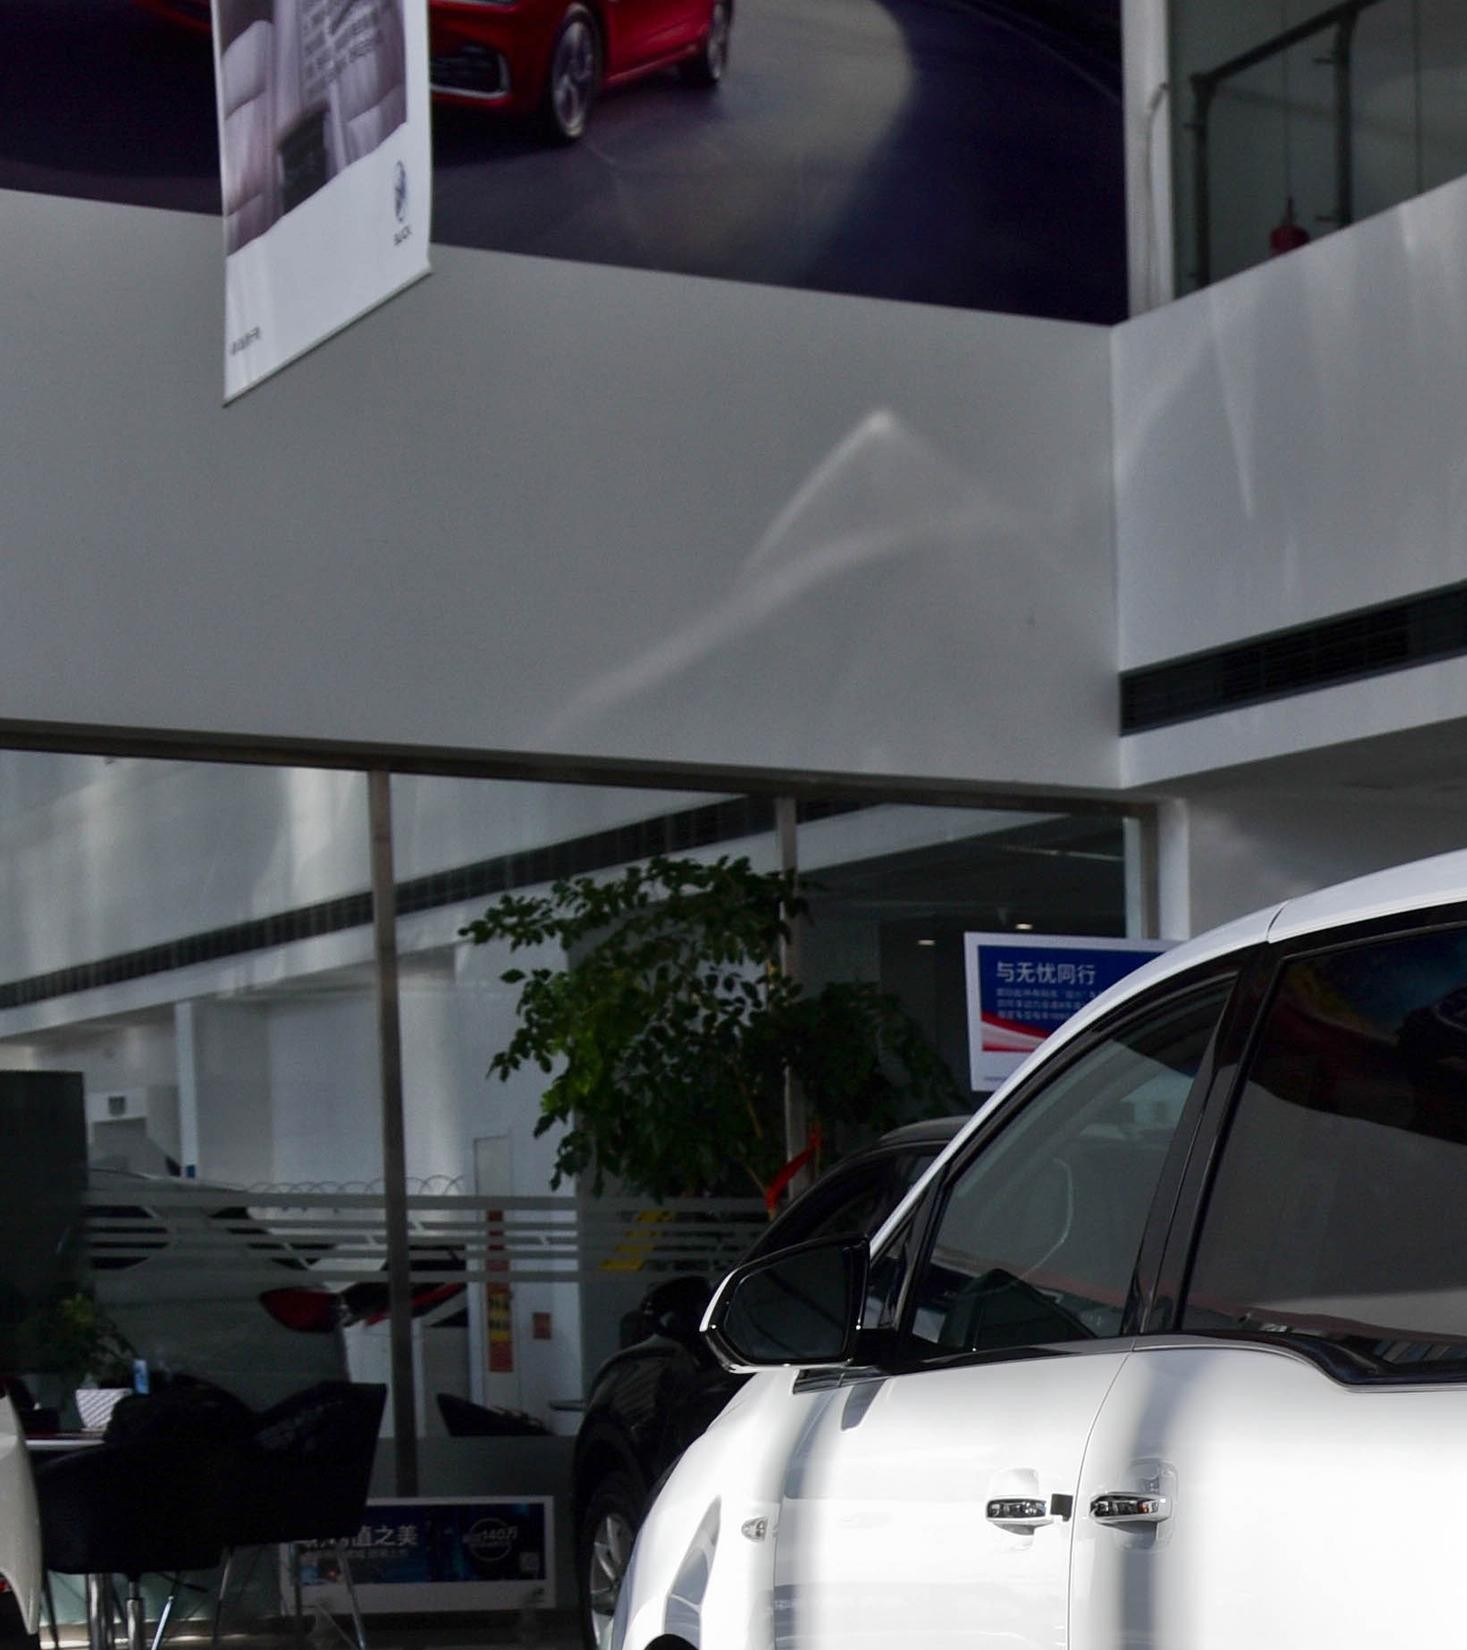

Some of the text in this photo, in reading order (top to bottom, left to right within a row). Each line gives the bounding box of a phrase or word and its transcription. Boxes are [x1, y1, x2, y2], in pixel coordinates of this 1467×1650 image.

[996, 960, 1096, 986] 与无忧同行
